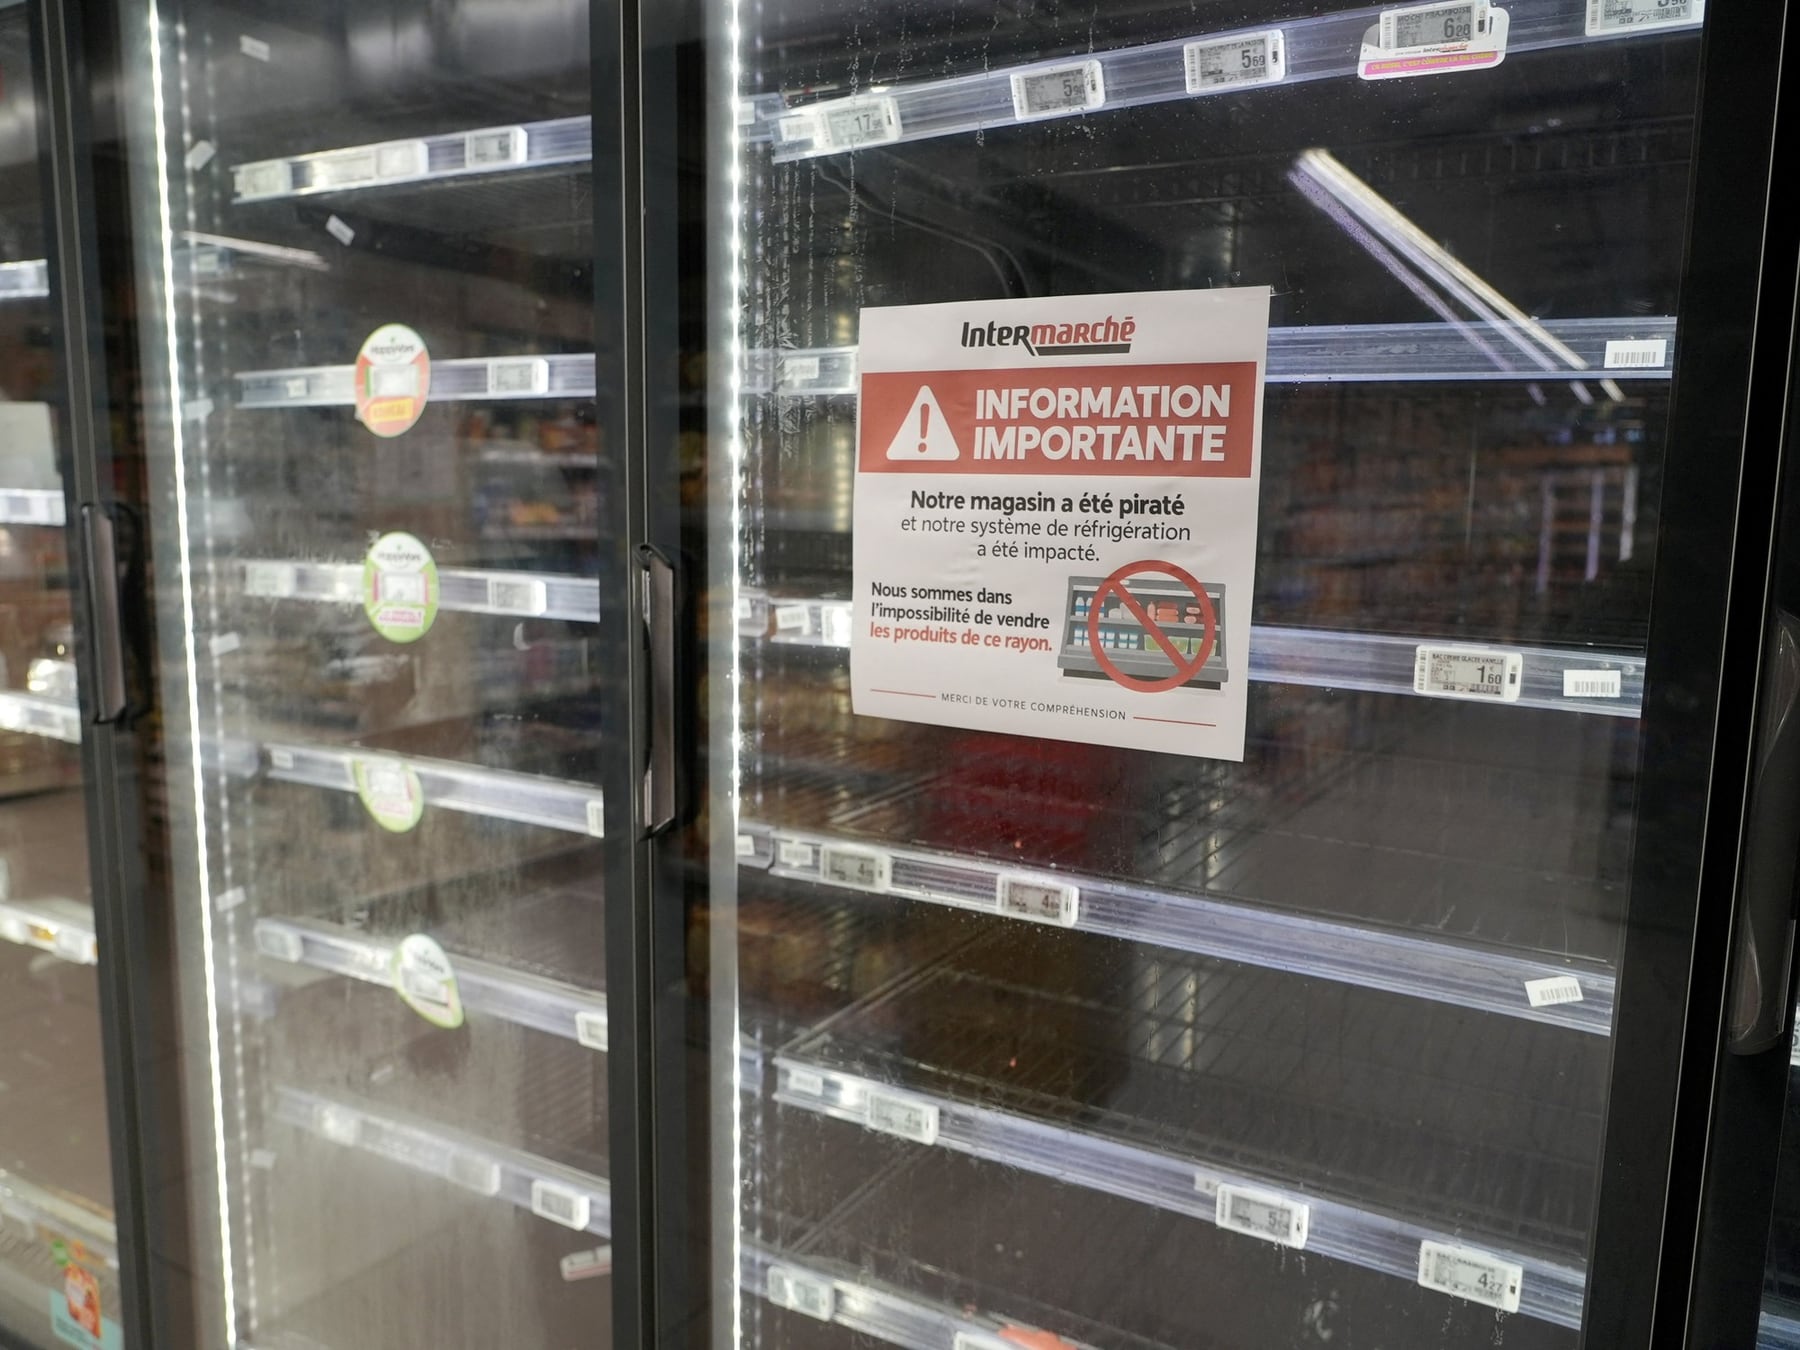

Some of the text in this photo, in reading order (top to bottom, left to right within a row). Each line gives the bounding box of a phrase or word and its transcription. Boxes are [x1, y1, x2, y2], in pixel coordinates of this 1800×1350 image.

[961, 315, 1135, 355] Intermarché
[976, 385, 1230, 419] INFORMATION
[974, 426, 1226, 461] IMPORTANTE
[911, 490, 1185, 519] Notre magasin a été piraté
[901, 516, 1191, 543] et notre système de réfrigération
[977, 540, 1099, 563] a été impacté.
[872, 582, 1012, 605] Nous sommes dans
[871, 602, 1049, 629] l'impossibilité de vendre
[871, 622, 1052, 653] les produits de ce rayon.
[942, 694, 1125, 720] MERCI DE VOTRE COMPRÉHENSION
